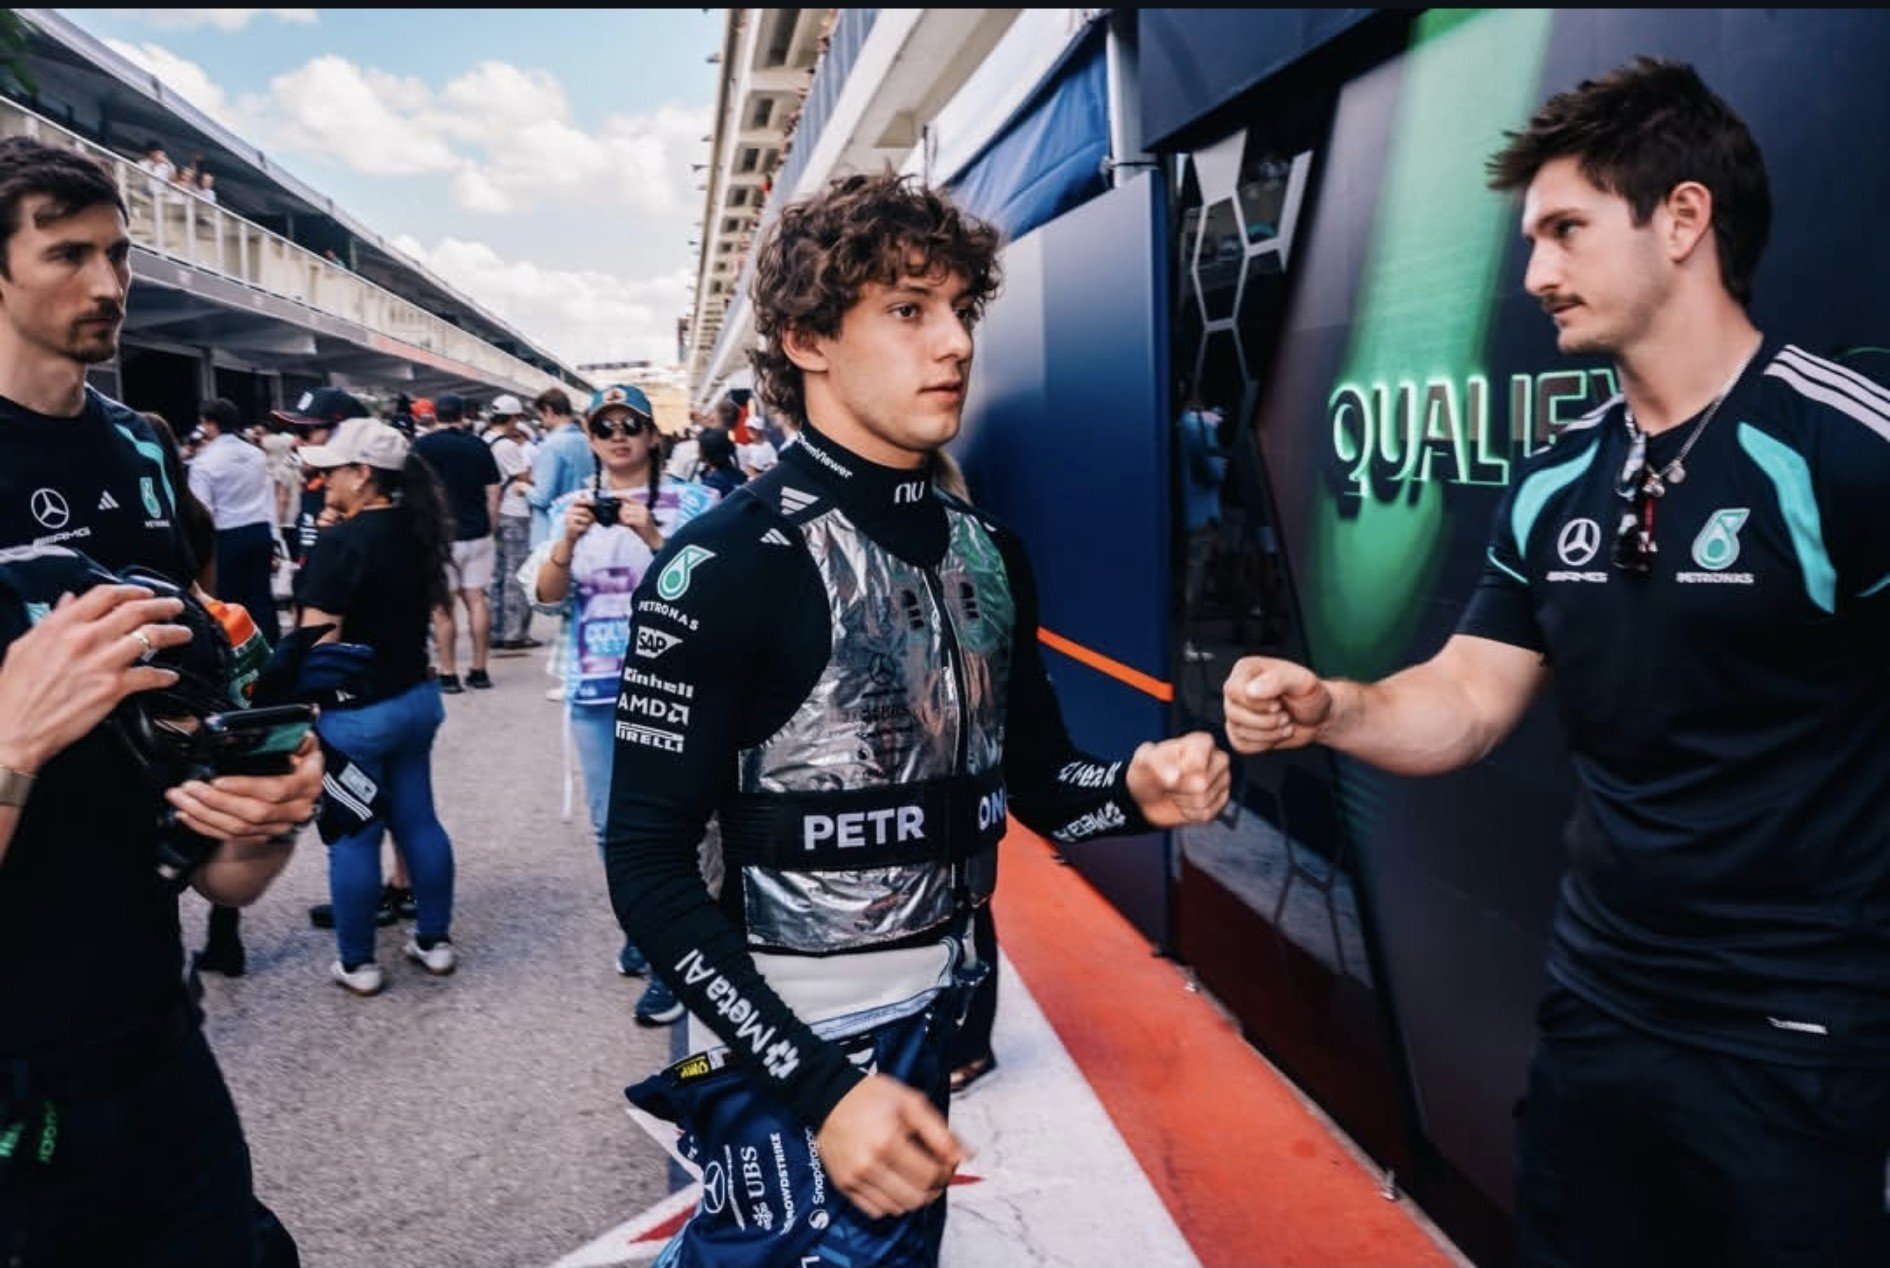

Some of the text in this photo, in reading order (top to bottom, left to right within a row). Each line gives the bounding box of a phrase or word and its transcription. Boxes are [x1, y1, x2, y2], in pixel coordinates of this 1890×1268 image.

[638, 600, 699, 631] PETRONAS
[637, 629, 670, 655] SAP
[623, 666, 694, 699] Einhell
[617, 692, 668, 718] AMD
[615, 720, 685, 754] PIRELLI
[803, 805, 925, 850] PETR
[673, 948, 777, 1054] Meta AI
[740, 1145, 766, 1199] UBS
